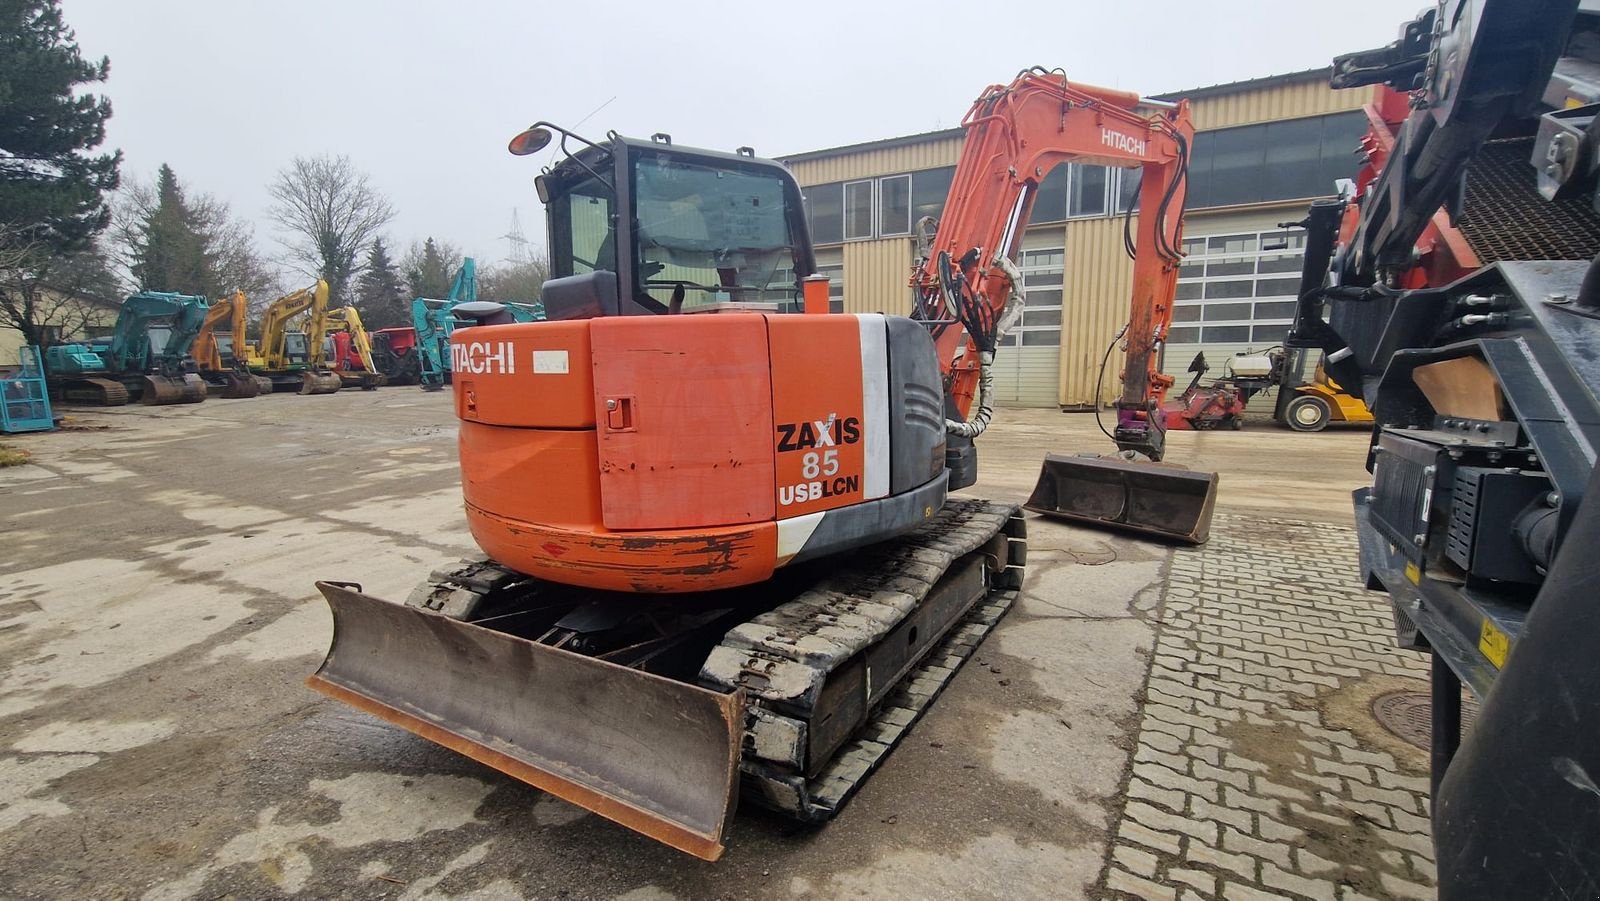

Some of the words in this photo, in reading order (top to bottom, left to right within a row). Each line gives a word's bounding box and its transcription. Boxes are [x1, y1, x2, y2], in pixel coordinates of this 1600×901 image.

[1102, 127, 1145, 156] HITACHI
[777, 413, 859, 452] ZAXIS
[803, 450, 838, 479] 85
[779, 476, 858, 505] USBLCN
